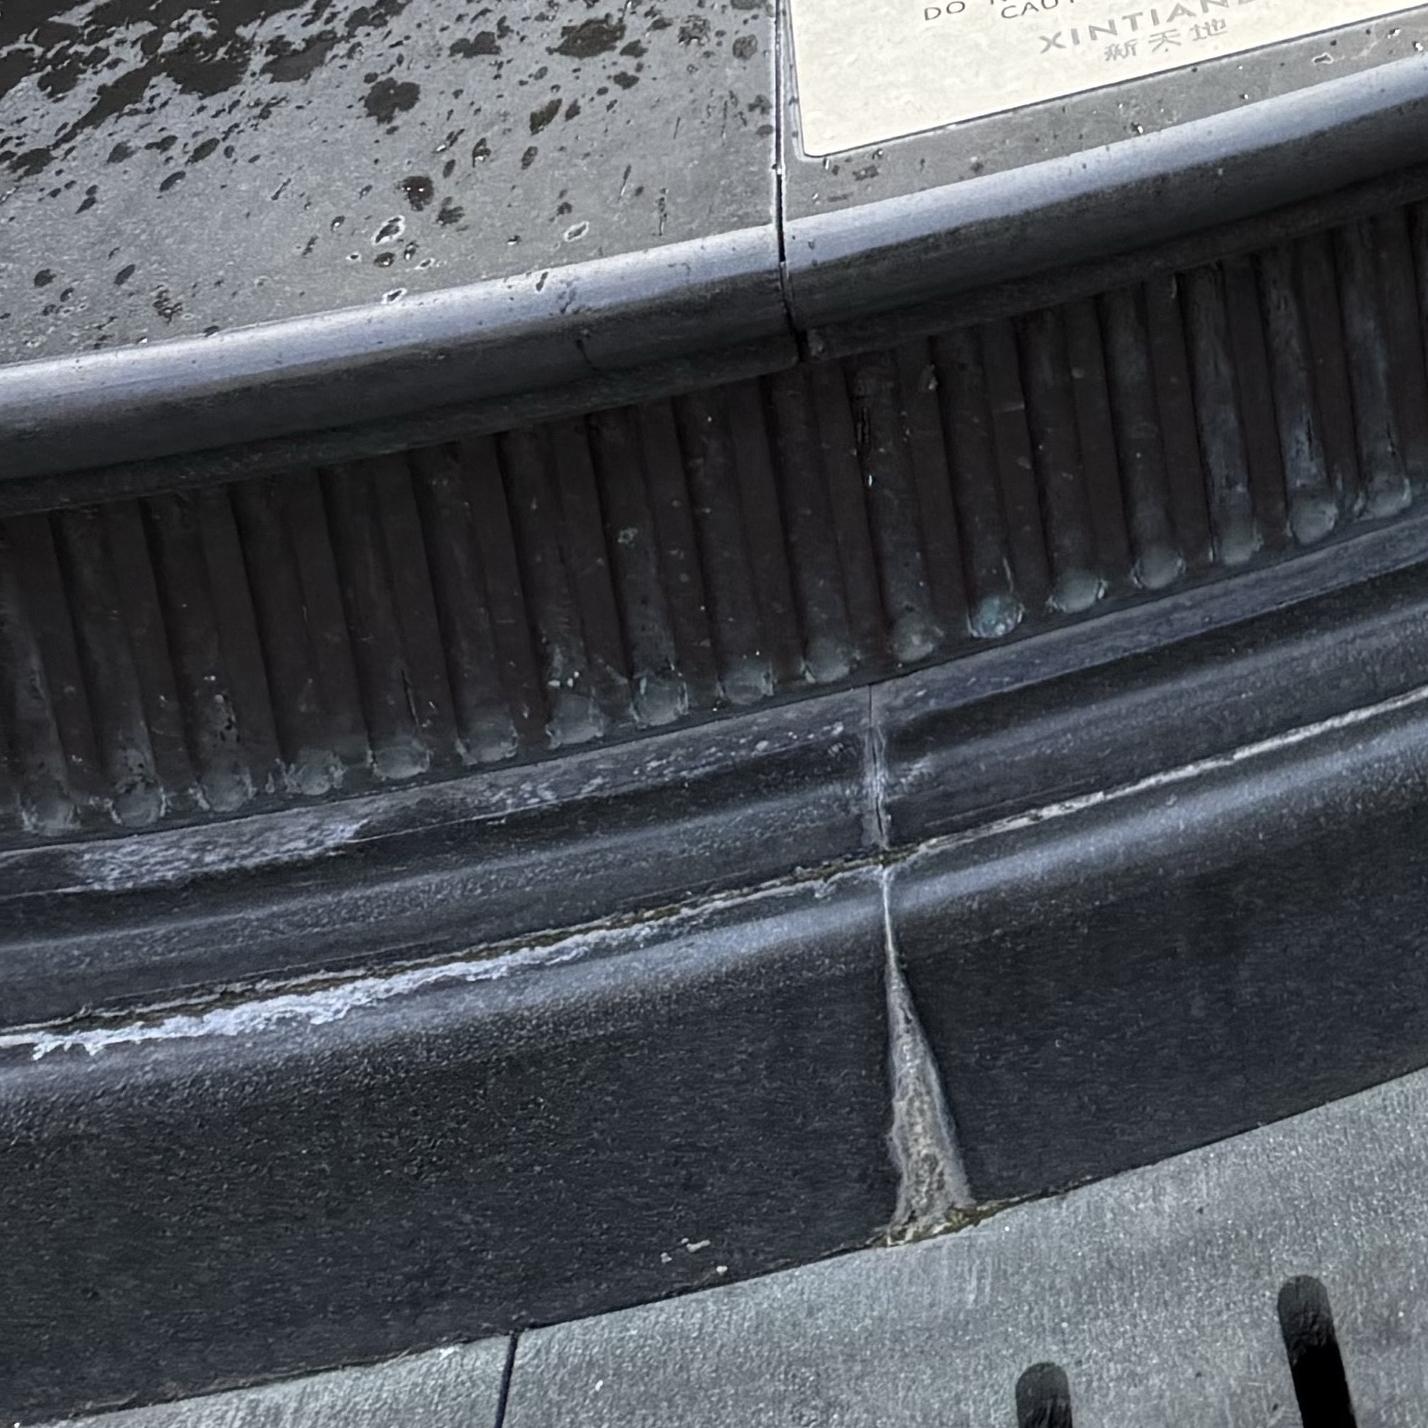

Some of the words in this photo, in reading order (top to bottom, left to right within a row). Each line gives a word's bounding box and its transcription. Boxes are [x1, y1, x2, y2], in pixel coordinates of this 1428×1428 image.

[923, 0, 967, 22] DO
[1103, 18, 1228, 61] 新天地
